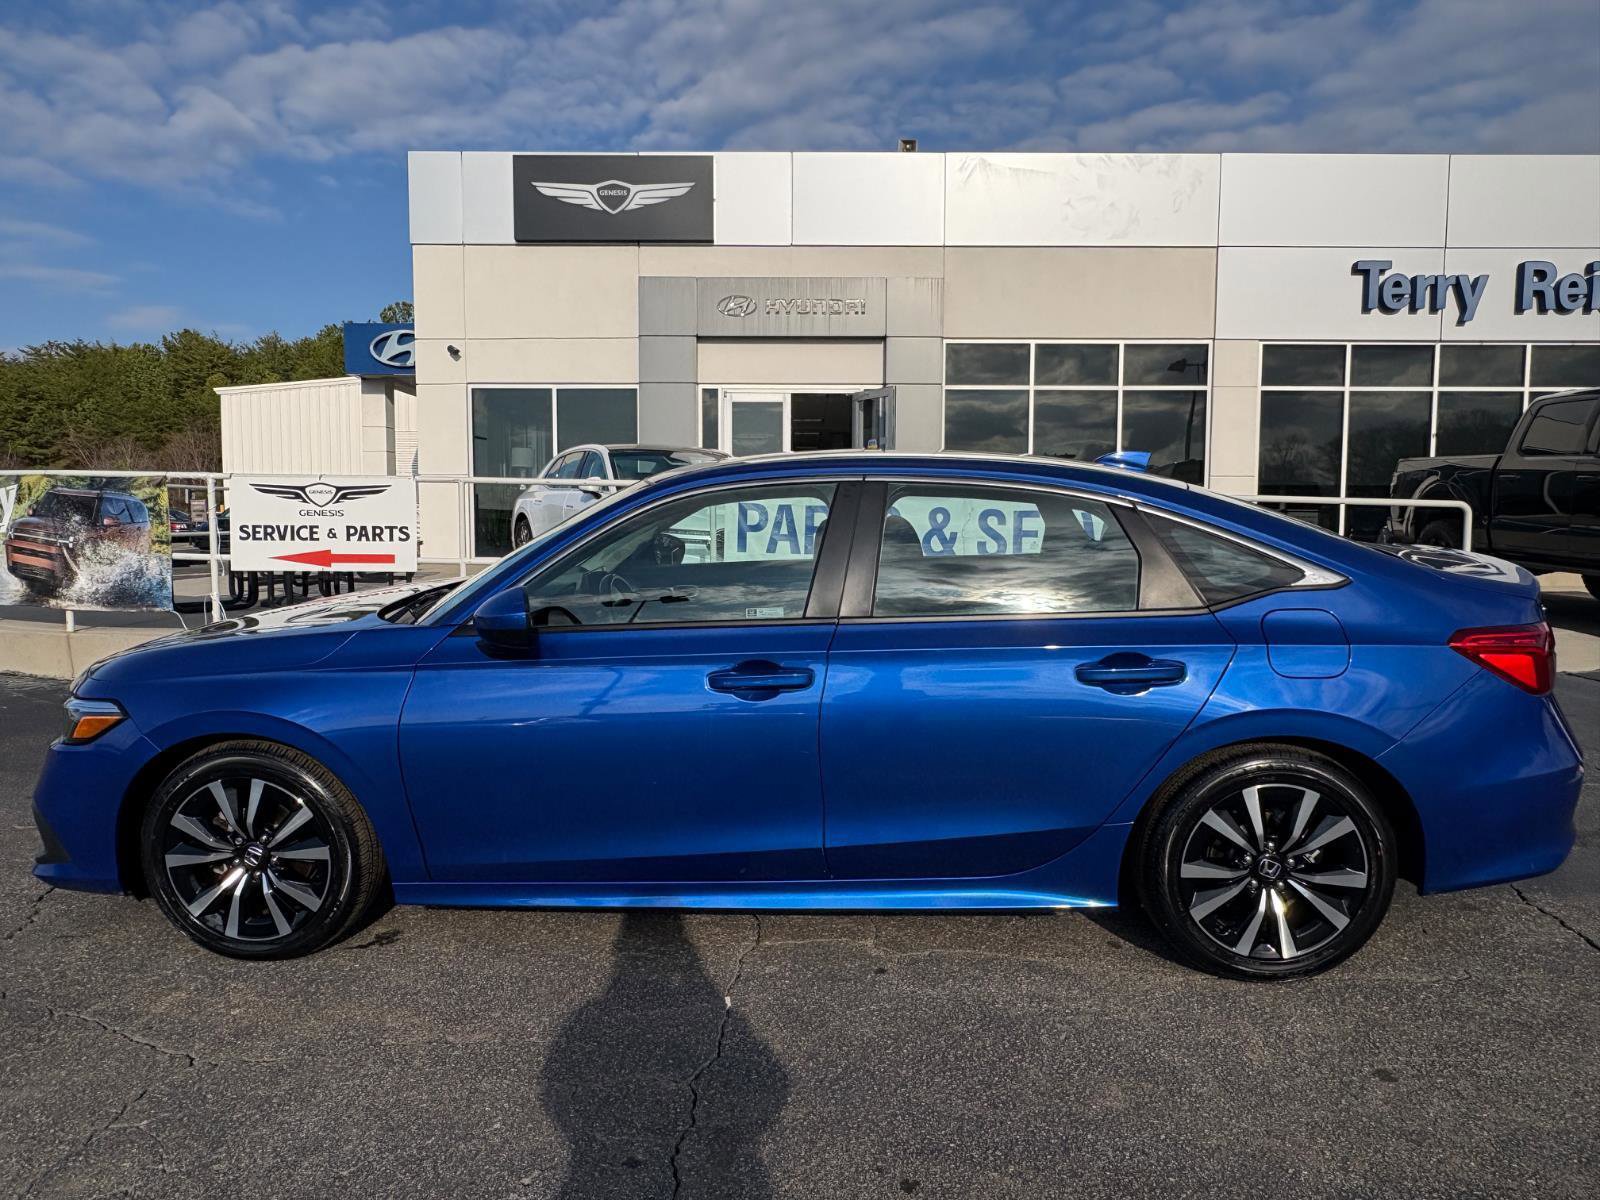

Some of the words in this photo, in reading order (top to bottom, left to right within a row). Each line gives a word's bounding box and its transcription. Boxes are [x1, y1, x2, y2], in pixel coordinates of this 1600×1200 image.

[1352, 260, 1490, 326] Terry
[1514, 260, 1600, 315] Rei
[765, 299, 866, 315] HYUNDAI
[299, 509, 345, 517] GENESIS
[238, 524, 320, 542] SERVICE
[326, 527, 338, 540] &
[345, 525, 411, 542] PARTS
